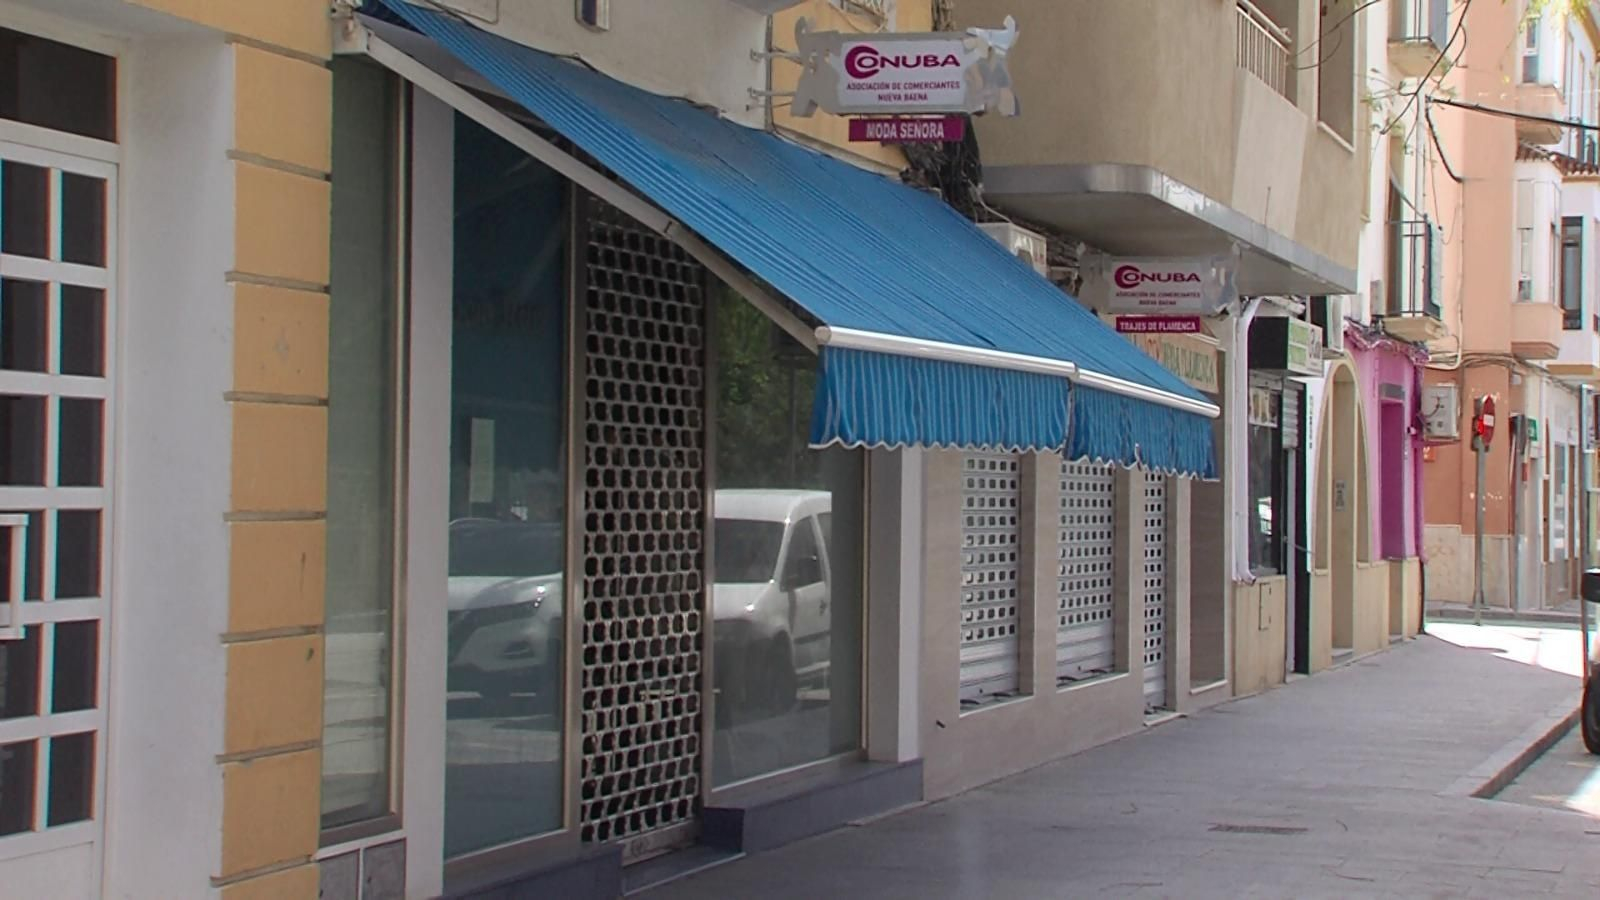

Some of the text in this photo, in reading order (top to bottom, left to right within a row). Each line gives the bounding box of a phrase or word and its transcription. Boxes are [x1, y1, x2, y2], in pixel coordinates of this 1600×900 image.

[845, 45, 960, 79] CONUBA
[892, 82, 901, 90] DE
[903, 81, 960, 90] COMERCIANTES
[878, 93, 902, 101] NUEVA
[866, 120, 945, 138] MODA SEÑORA
[1114, 265, 1200, 289] CONUBA
[1119, 321, 1197, 331] TRAJES DE FLAMENCA
